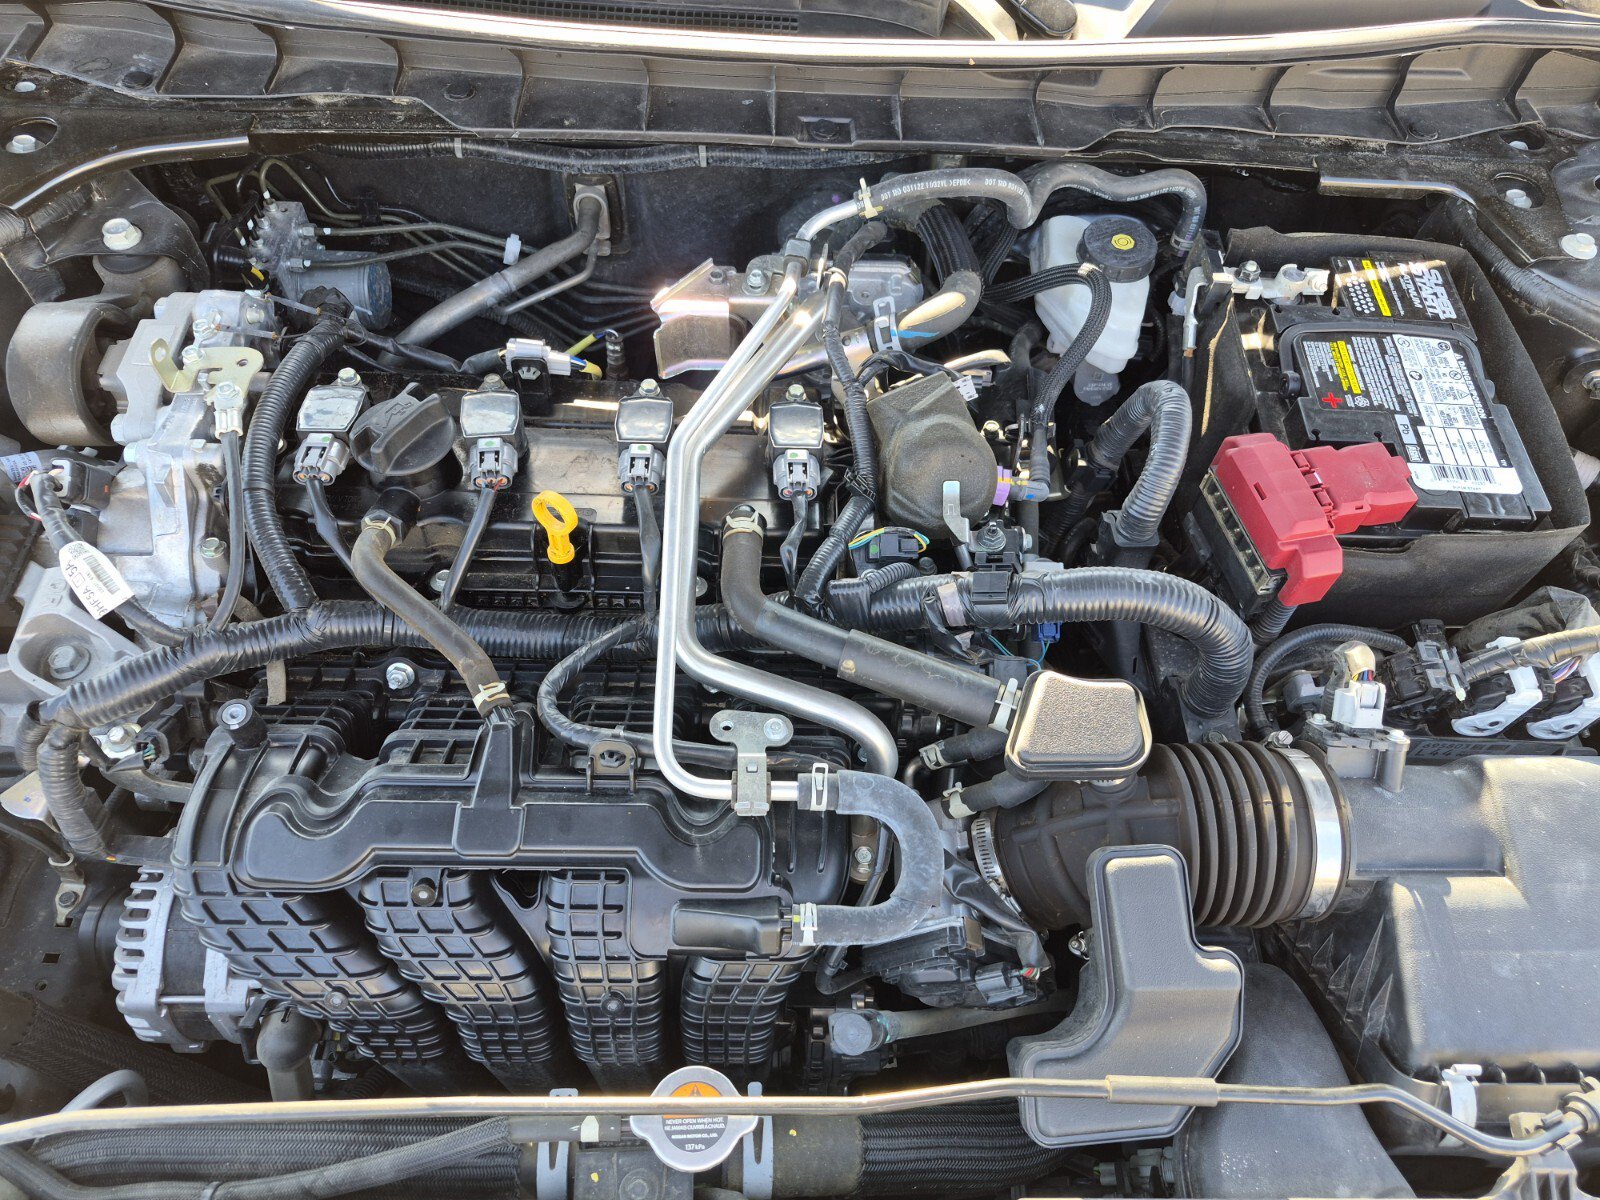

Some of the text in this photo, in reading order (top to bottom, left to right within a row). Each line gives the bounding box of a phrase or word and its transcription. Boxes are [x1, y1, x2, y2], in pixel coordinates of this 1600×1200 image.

[1409, 262, 1439, 318] START
[1427, 268, 1457, 320] SUPER
[1400, 423, 1410, 434] Pb
